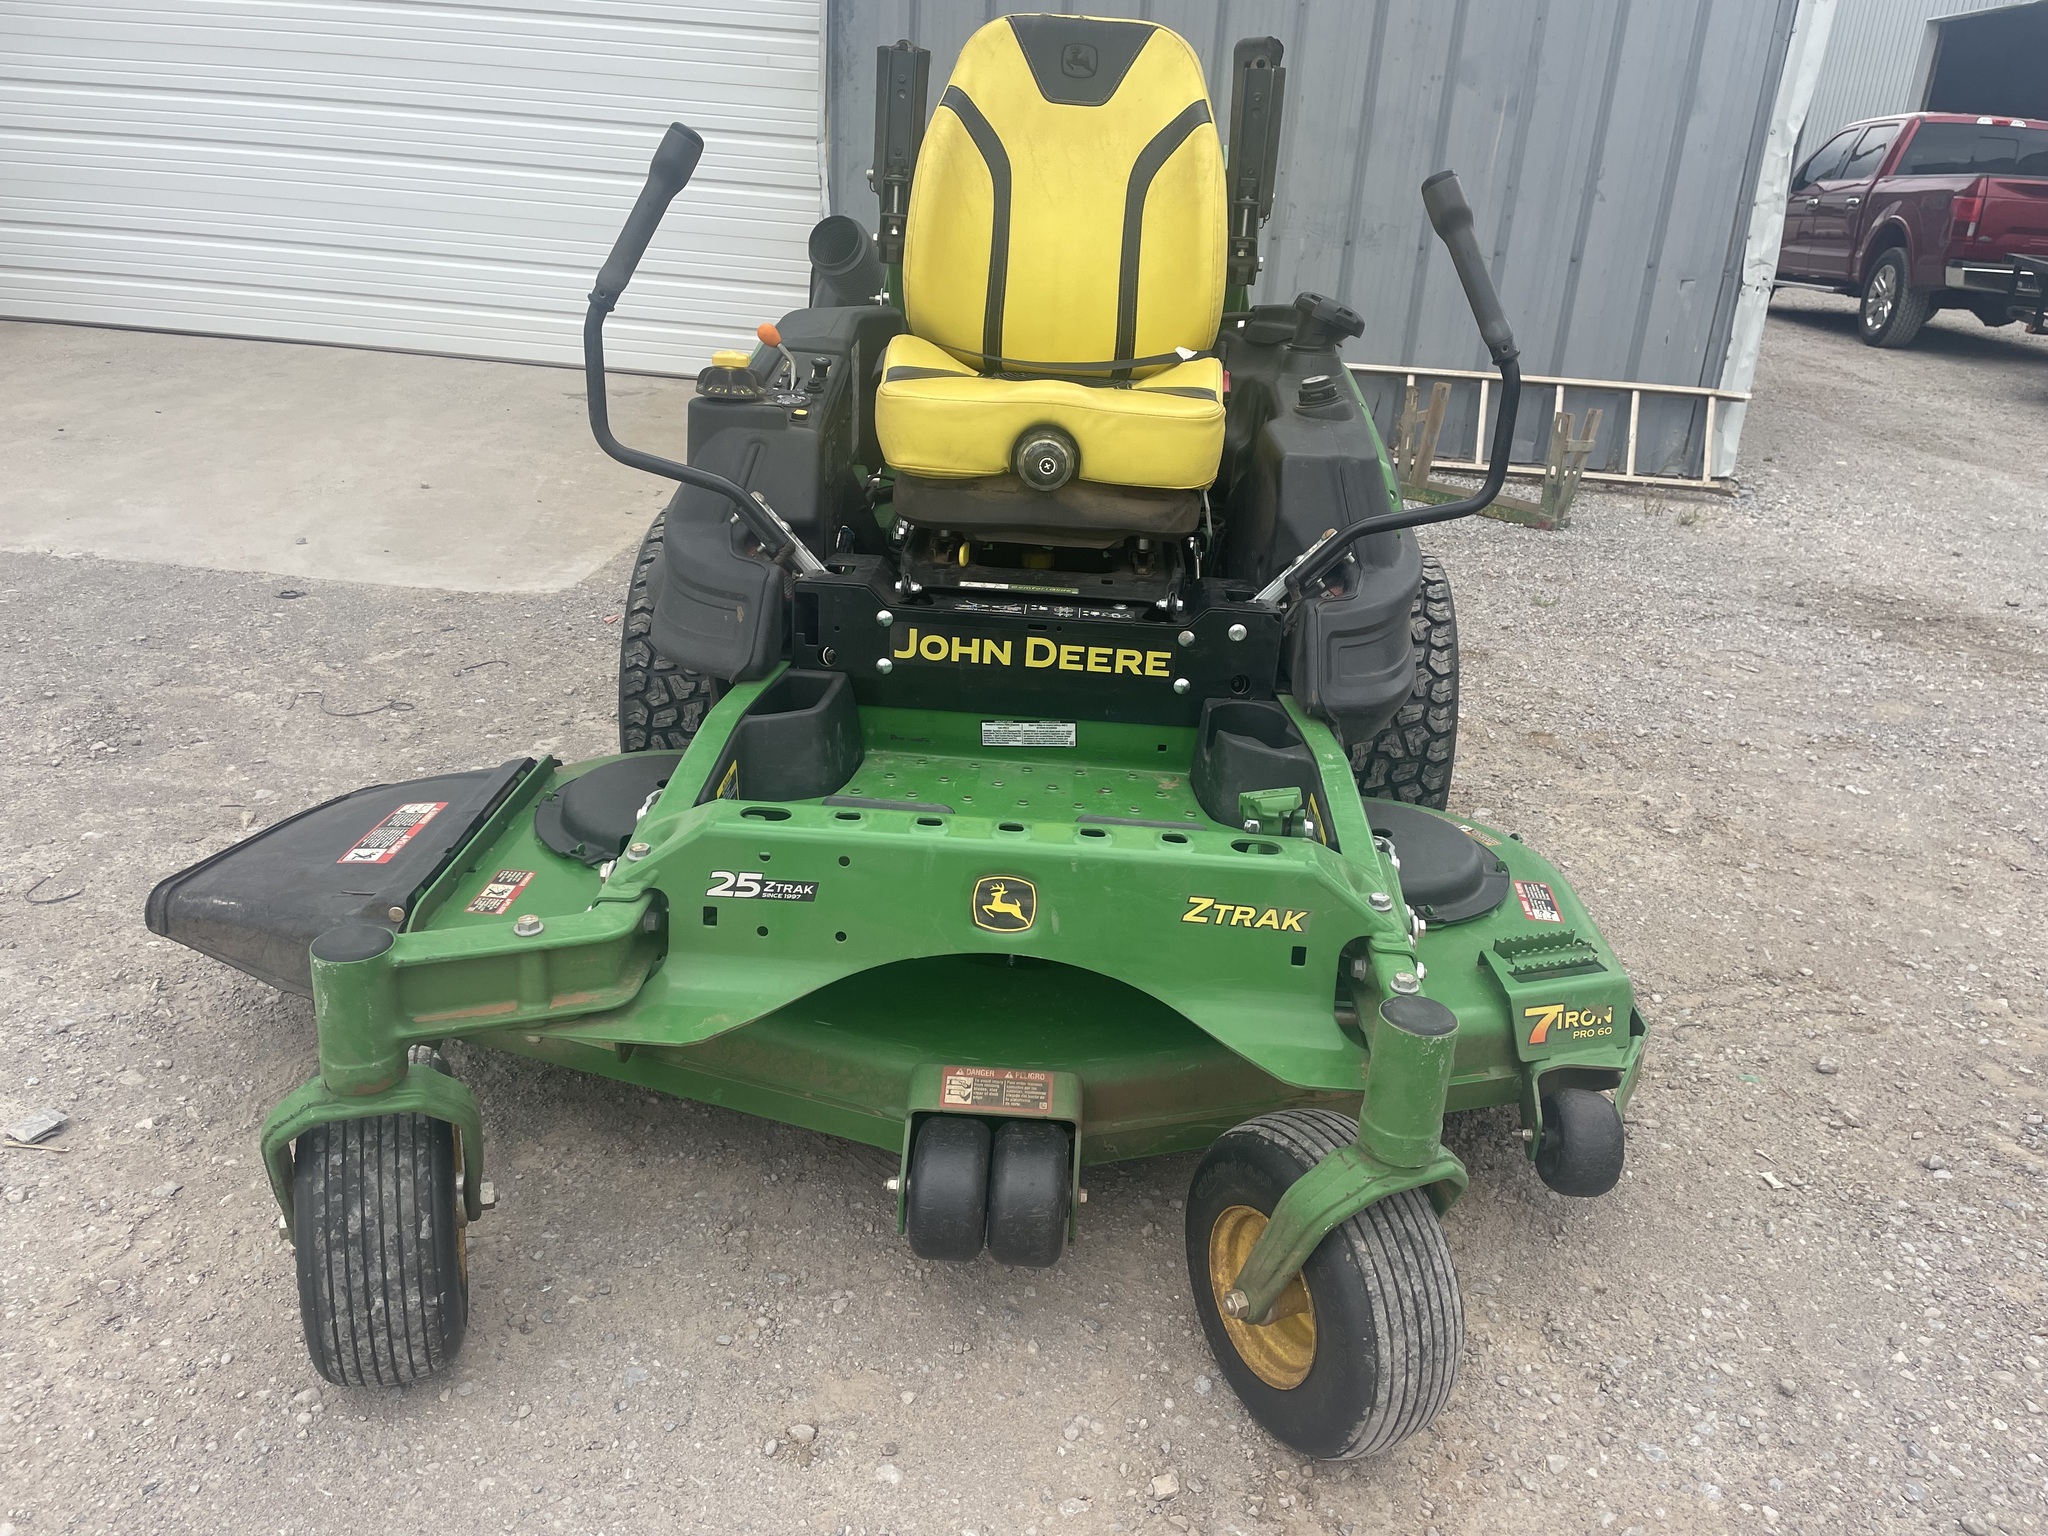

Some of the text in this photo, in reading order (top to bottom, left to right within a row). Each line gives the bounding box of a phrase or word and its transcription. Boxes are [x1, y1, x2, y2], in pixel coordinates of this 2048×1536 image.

[894, 628, 1172, 677] JOHN DEERE
[706, 871, 814, 898] 25 ZTRAK
[1182, 896, 1308, 932] ZTRAK
[1573, 1026, 1613, 1039] PRO 60
[966, 1068, 995, 1077] DANGER
